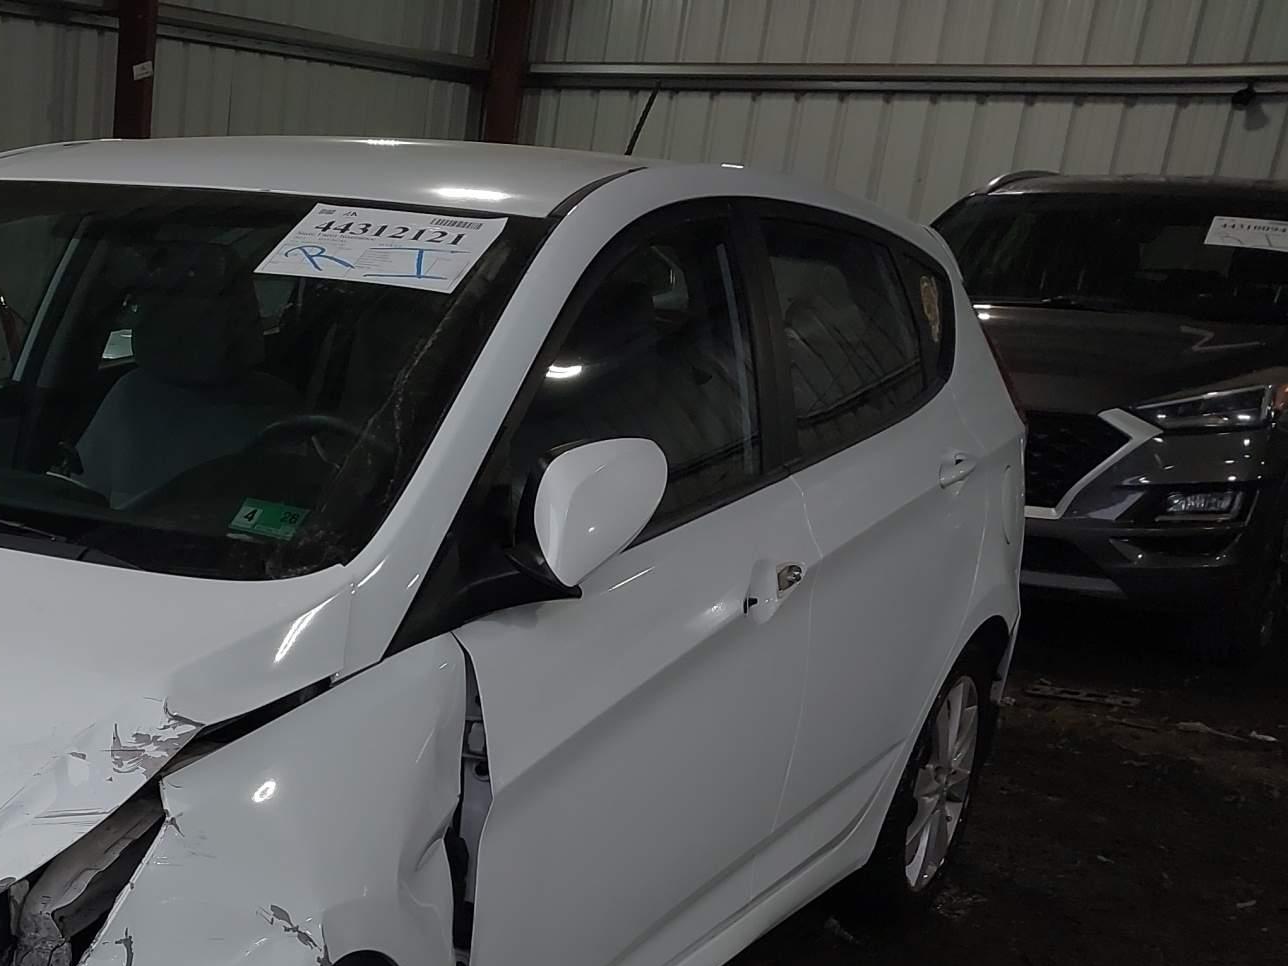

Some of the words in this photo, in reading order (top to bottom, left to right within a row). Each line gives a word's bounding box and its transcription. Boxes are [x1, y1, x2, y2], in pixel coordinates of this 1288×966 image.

[315, 220, 466, 246] 44312121
[284, 245, 355, 272] R
[243, 508, 258, 522] 4
